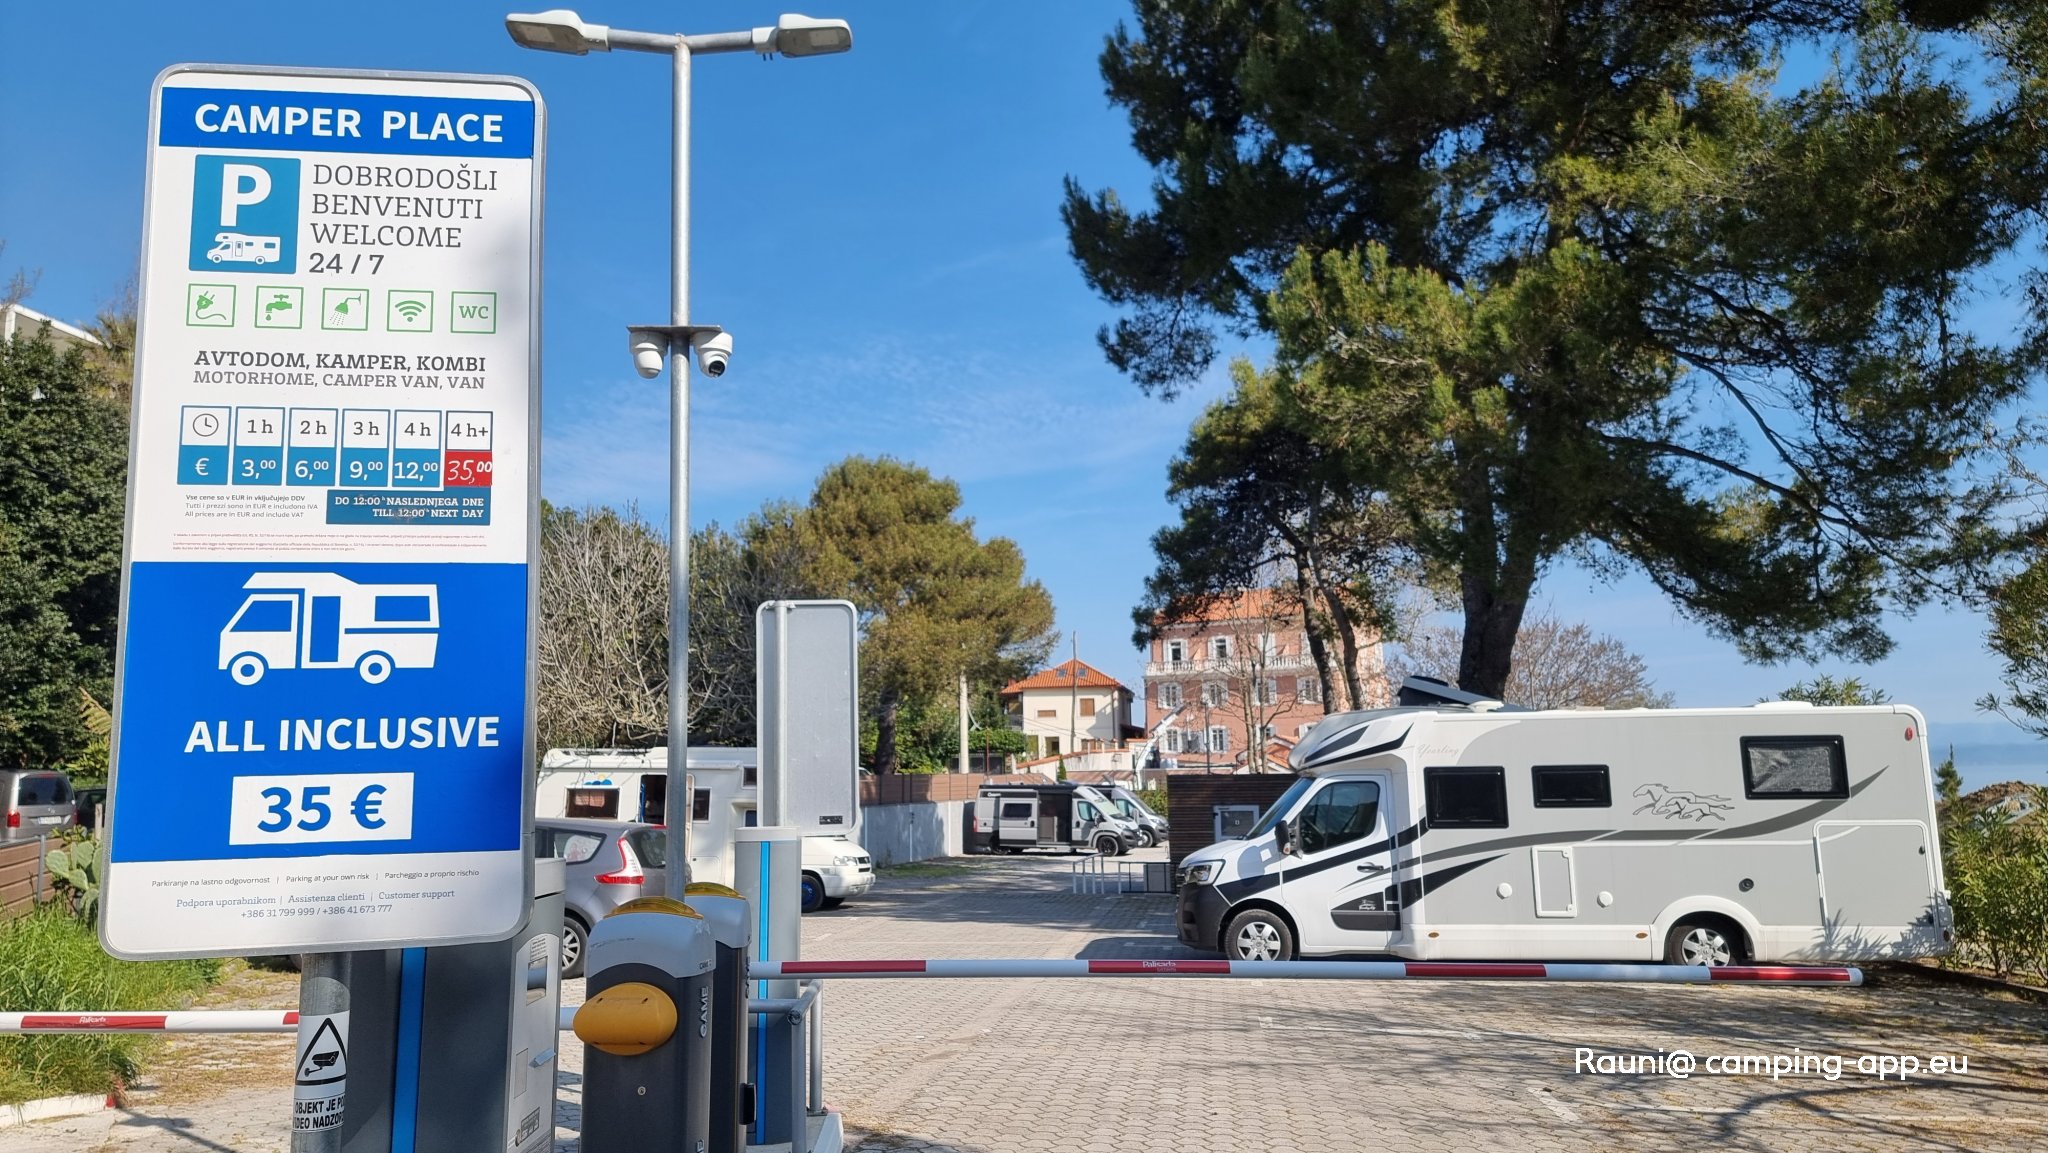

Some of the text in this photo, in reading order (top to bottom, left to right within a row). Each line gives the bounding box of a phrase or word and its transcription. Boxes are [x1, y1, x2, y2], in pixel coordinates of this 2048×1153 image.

[195, 103, 503, 142] CAMPER PLACE
[312, 163, 498, 191] DOBRODOŠLI
[220, 163, 272, 227] P
[311, 193, 483, 219] BENVENUTI
[309, 222, 462, 248] WELCOME
[308, 253, 343, 274] 24
[369, 255, 385, 275] 7
[458, 304, 489, 320] WC
[194, 350, 486, 372] AVTODOM, KAMPER, KOMBI
[193, 370, 485, 390] MOTORHOME, CAMPER VAN, VAN
[195, 457, 210, 476] €
[334, 496, 350, 505] DO
[386, 497, 458, 508] NASLEDNJEGA
[462, 498, 484, 507] DNE
[372, 508, 394, 517] TILL
[430, 509, 459, 518] NEXT
[462, 509, 485, 518] DAY
[184, 716, 500, 753] ALL INCLUSIVE
[257, 784, 387, 833] 35 €
[151, 878, 188, 888] Parkiranje
[201, 878, 223, 886] lastno
[225, 877, 270, 886] odgovornost
[286, 875, 313, 884] Parking
[322, 875, 338, 883] your
[384, 871, 422, 880] Parcheggio
[430, 870, 455, 879] proprio
[456, 869, 480, 877] rischio
[176, 890, 455, 909] Podpora uporabnikom Assistenza clienti Customer support
[241, 909, 265, 918] +386
[266, 909, 277, 918] 31
[278, 908, 296, 917] 799
[297, 907, 315, 916] 999
[322, 906, 346, 915] +386
[346, 905, 358, 914] 41
[359, 905, 376, 913] 673
[377, 904, 393, 912] 777
[294, 1101, 325, 1115] OBJEKT
[326, 1098, 336, 1112] JE
